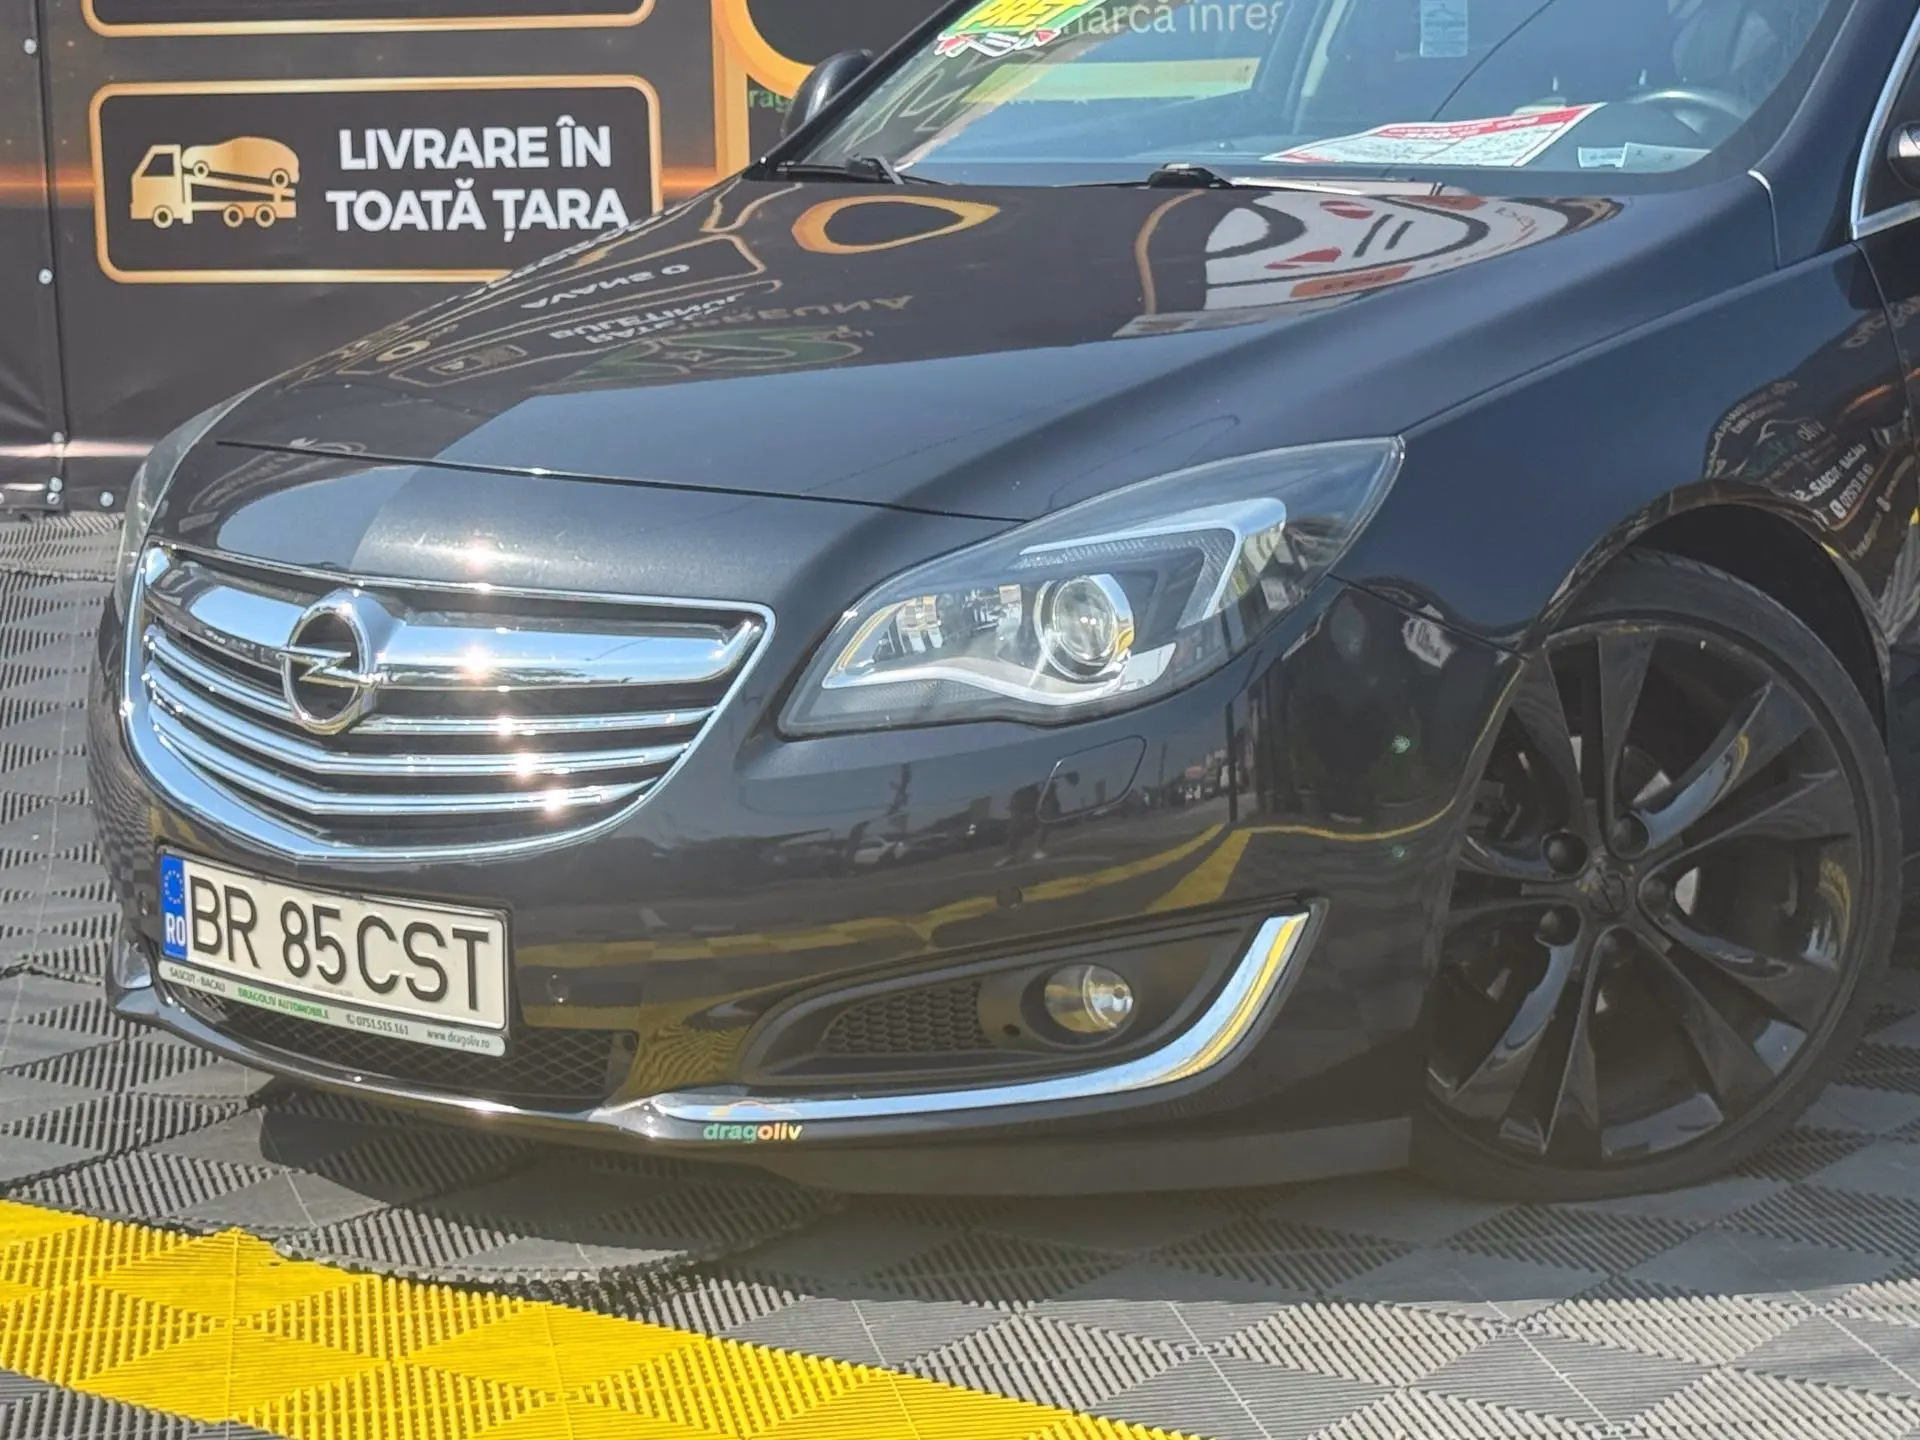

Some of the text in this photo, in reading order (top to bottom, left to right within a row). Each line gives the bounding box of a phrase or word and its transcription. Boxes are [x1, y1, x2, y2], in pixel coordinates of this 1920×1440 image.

[338, 114, 612, 171] LIVRARE ÎN
[325, 176, 630, 243] TOATĂ ȚARA
[165, 914, 187, 947] RO
[190, 875, 262, 970] BR
[703, 1122, 803, 1144] dragoliv
